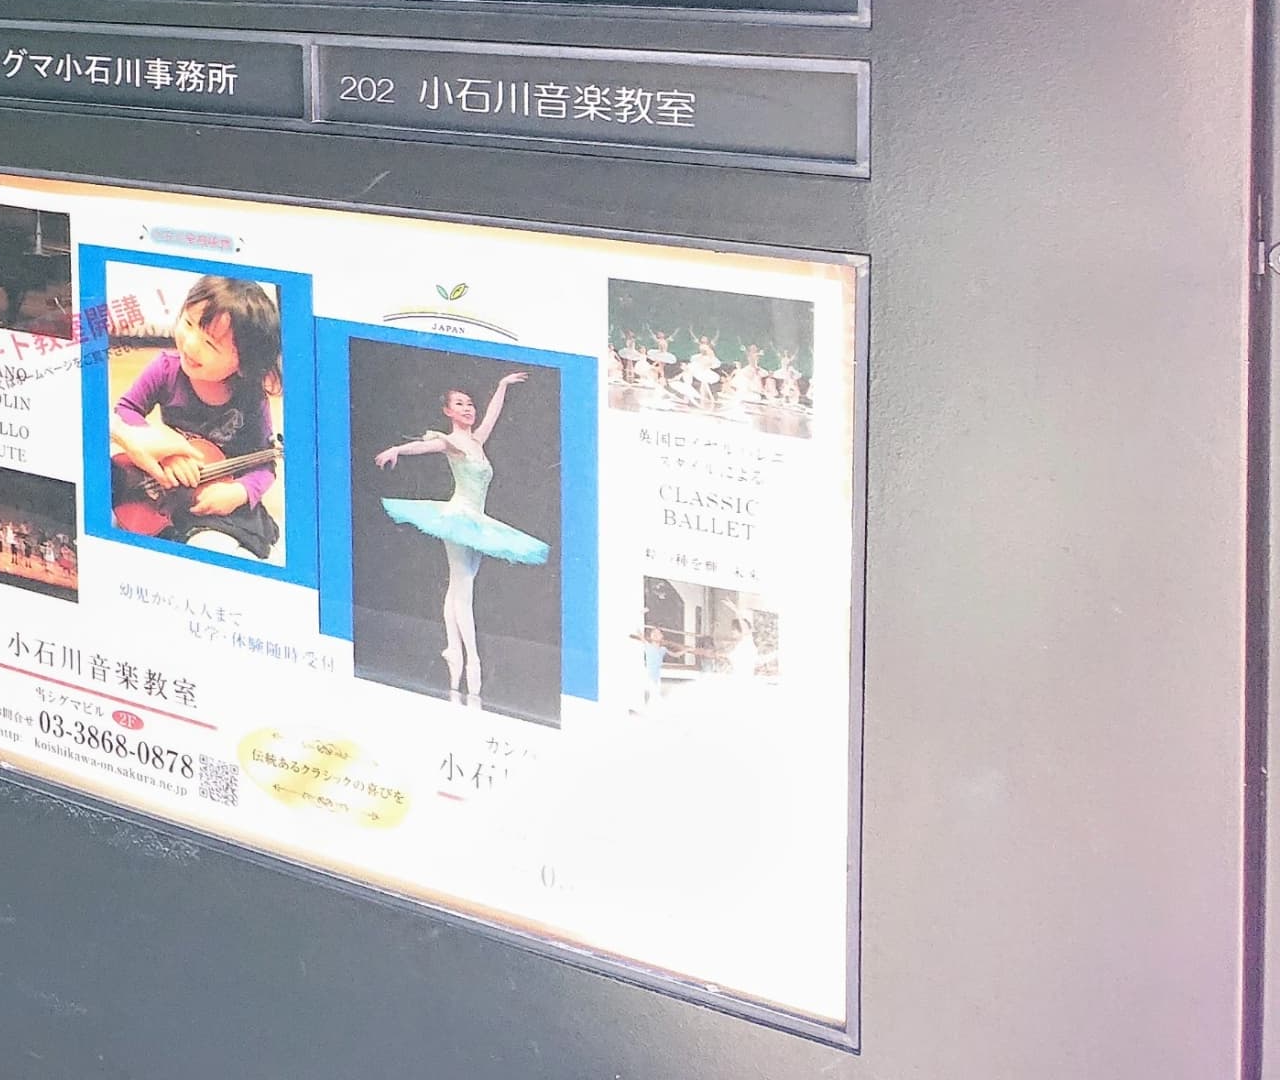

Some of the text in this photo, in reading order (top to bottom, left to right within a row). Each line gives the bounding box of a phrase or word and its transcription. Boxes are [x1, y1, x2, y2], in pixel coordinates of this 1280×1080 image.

[339, 76, 696, 127] 202 小石川音楽教室
[432, 323, 466, 335] JAPAN
[659, 484, 759, 517] CLASSIC
[663, 508, 756, 541] BALLET
[6, 630, 199, 710] 小石川音楽教室
[118, 714, 138, 729] 2F
[39, 708, 196, 781] 03-3868-0878
